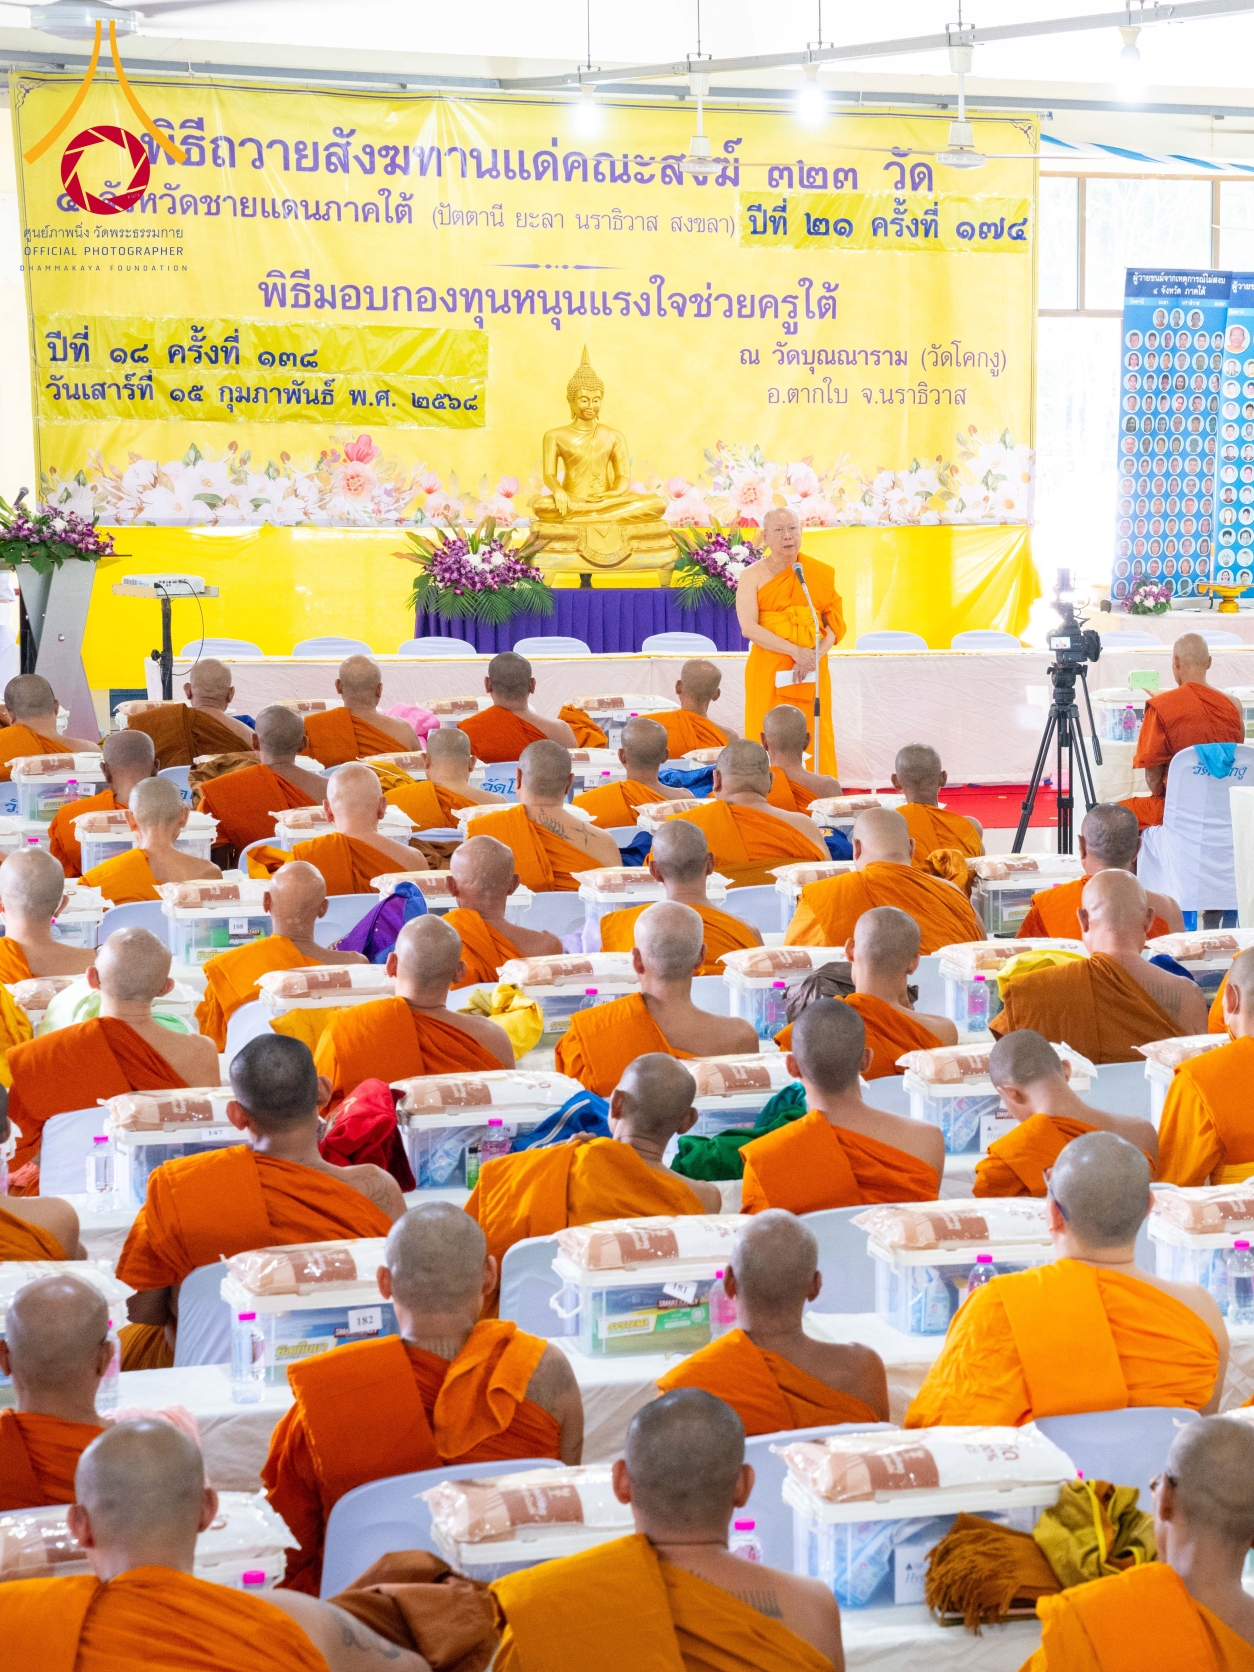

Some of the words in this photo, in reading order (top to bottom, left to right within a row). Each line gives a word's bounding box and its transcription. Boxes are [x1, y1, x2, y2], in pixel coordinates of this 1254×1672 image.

[767, 159, 859, 190] ๓๒๓
[883, 145, 934, 193] วัด
[98, 179, 414, 225] จัหวัดชายแดนภาคใต้
[432, 202, 504, 231] (ปัตตานี
[517, 210, 565, 230] ยะลา
[576, 207, 659, 233] นราธิวาส
[670, 211, 736, 237] สงขลา)
[747, 199, 787, 236] ปีที่
[805, 212, 854, 238] ๒๑
[871, 197, 939, 239] ครั้งที่
[955, 217, 1029, 241] ๑๗๔
[258, 269, 839, 336] พิธีมอบกองทุนหนุนแรงใจช่วยครูใต้
[46, 326, 91, 364] ปีที่
[109, 345, 149, 364] ๑๘
[167, 326, 241, 366] ครั้งที่
[257, 349, 319, 369] ๑๓๘
[740, 347, 760, 366] ณ
[773, 342, 908, 375] วัดบุณณาราม
[921, 341, 1008, 381] (วัดโคกงู)
[45, 366, 154, 402] วันเสาร์ที่
[169, 385, 203, 402] ๑๕
[219, 378, 335, 413] กุมภาพันธ์
[349, 387, 397, 408] พ.ศ.
[410, 389, 479, 412] ๒๕๖๘
[767, 378, 849, 405] อ.ตากใบ
[861, 380, 968, 407] จ.นราธิวาส
[671, 1281, 689, 1294] 181
[356, 1315, 374, 1326] 182
